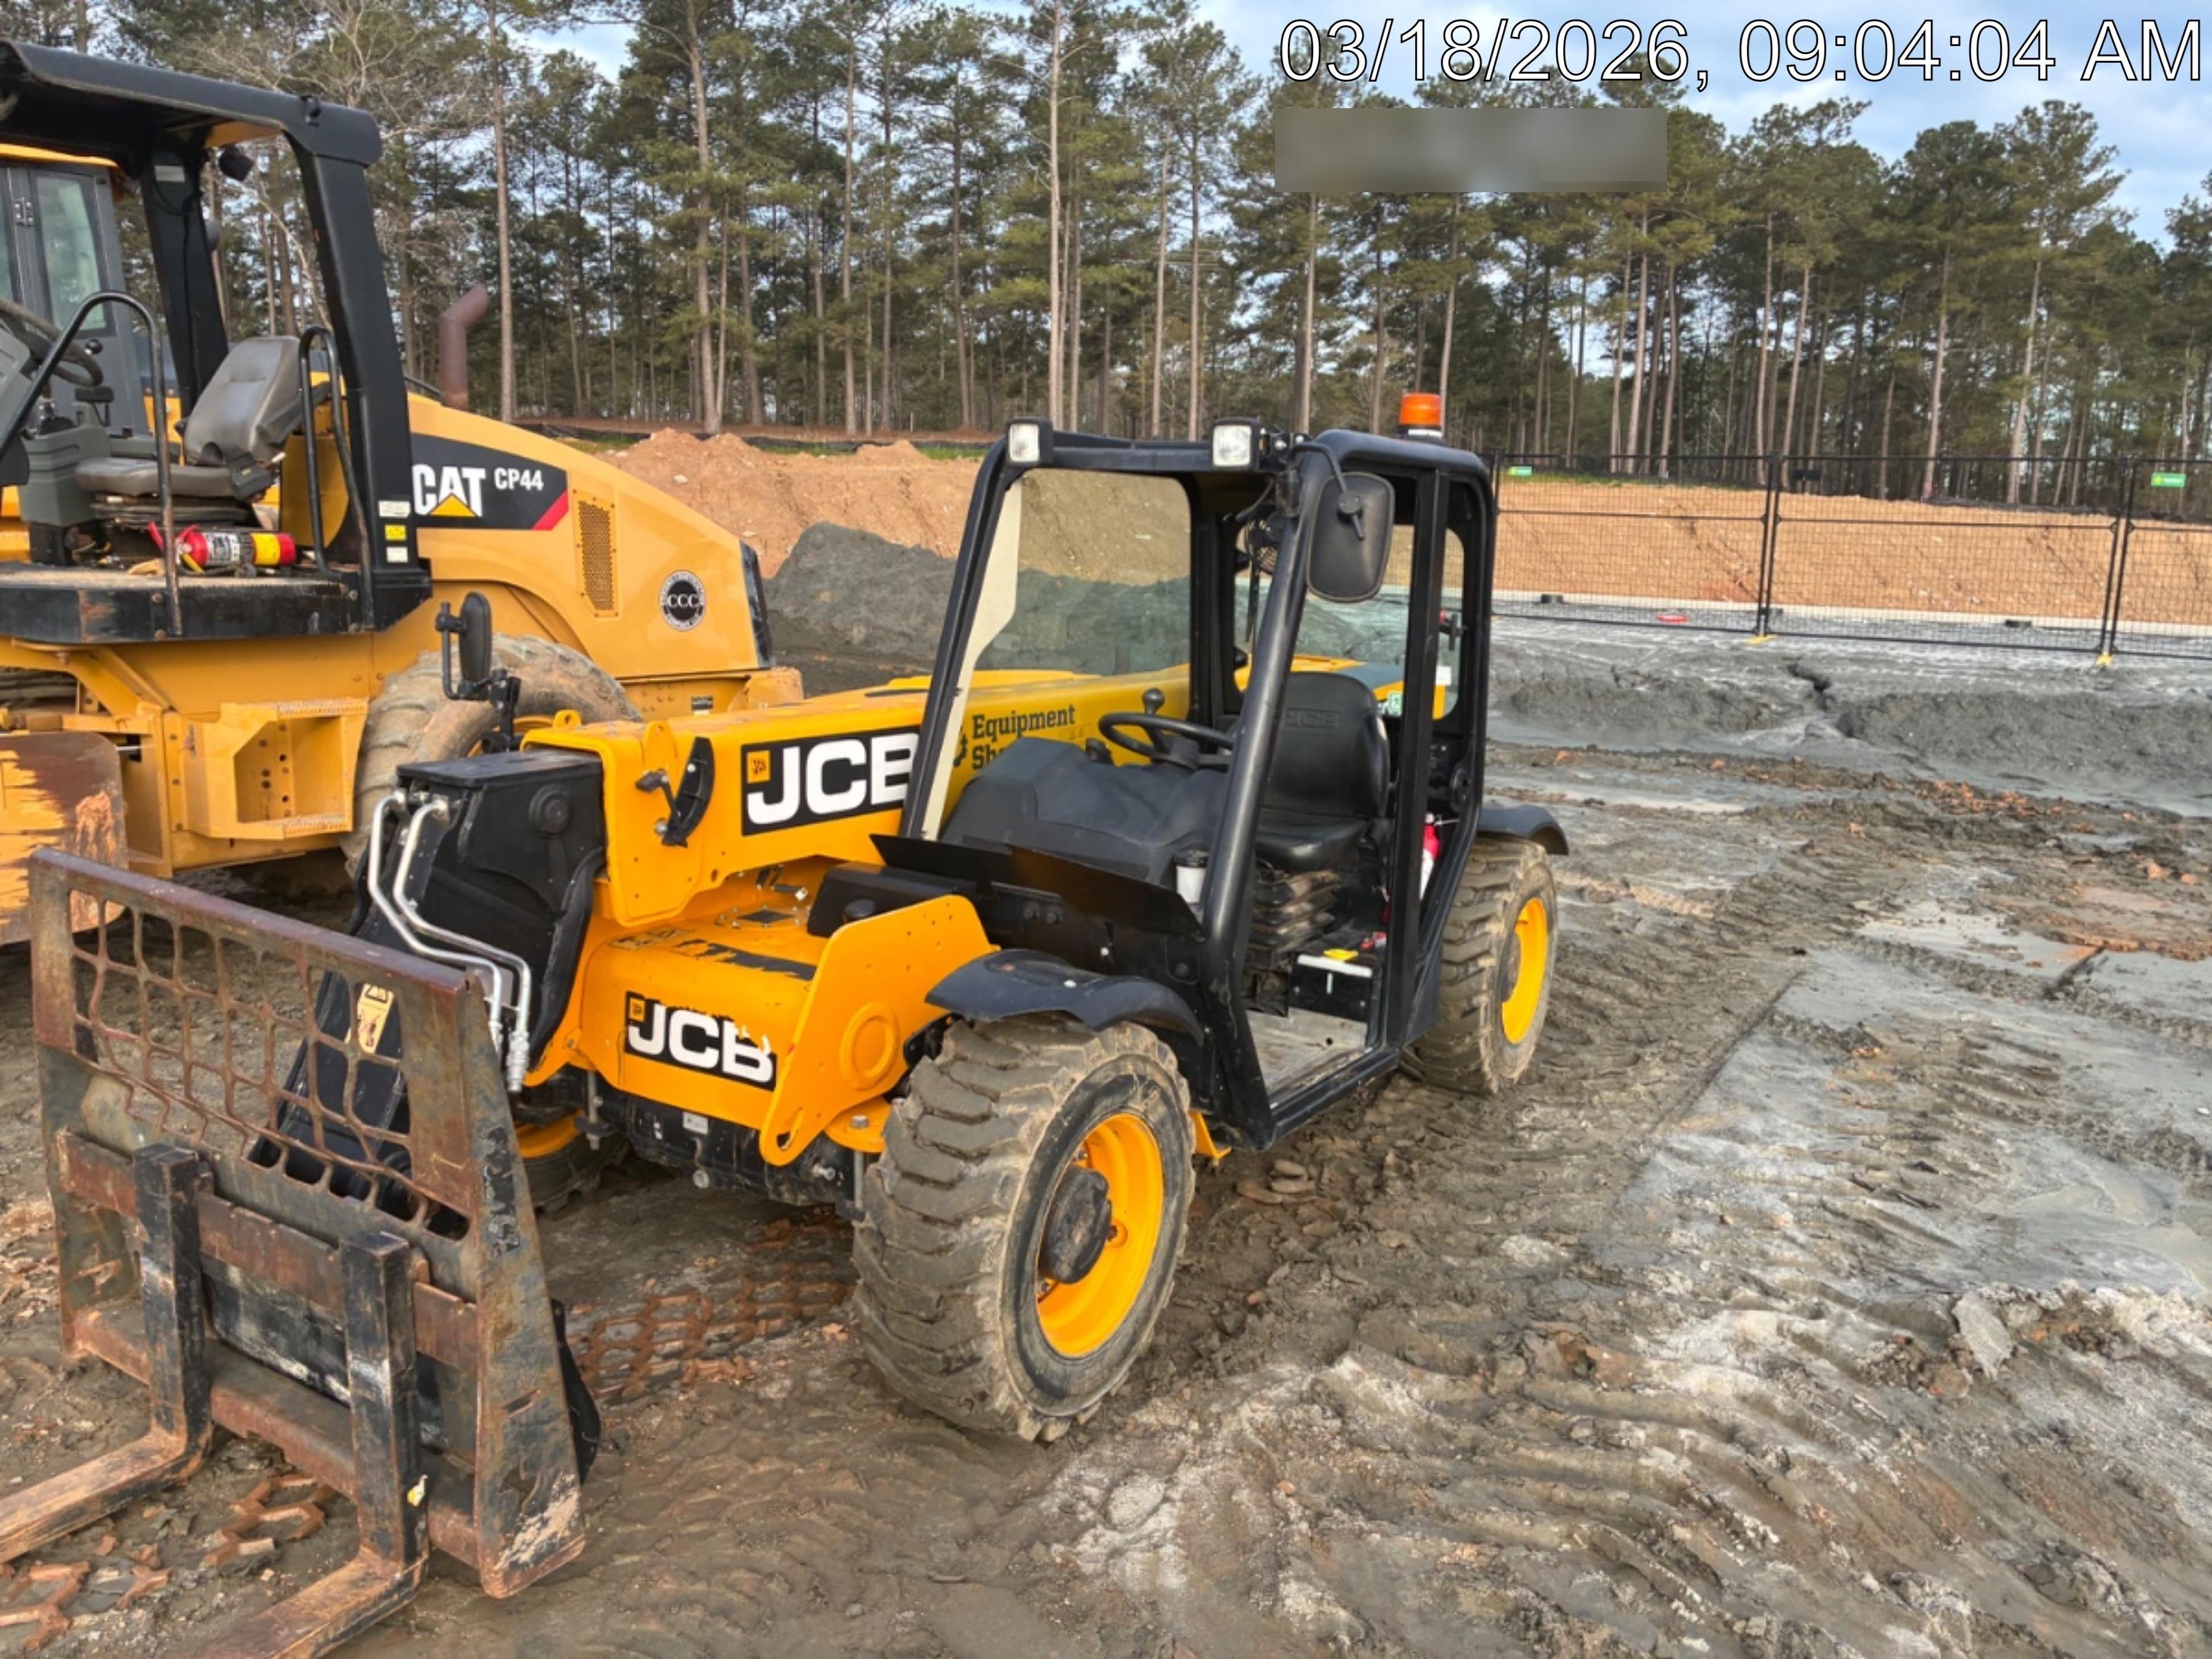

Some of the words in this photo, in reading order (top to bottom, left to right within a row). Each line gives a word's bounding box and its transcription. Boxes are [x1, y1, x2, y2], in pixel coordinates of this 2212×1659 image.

[412, 464, 486, 517] CAT
[493, 467, 544, 491] CP44
[972, 704, 1075, 742] Equipment
[746, 733, 919, 825] JCB
[628, 1003, 774, 1083] JCB
